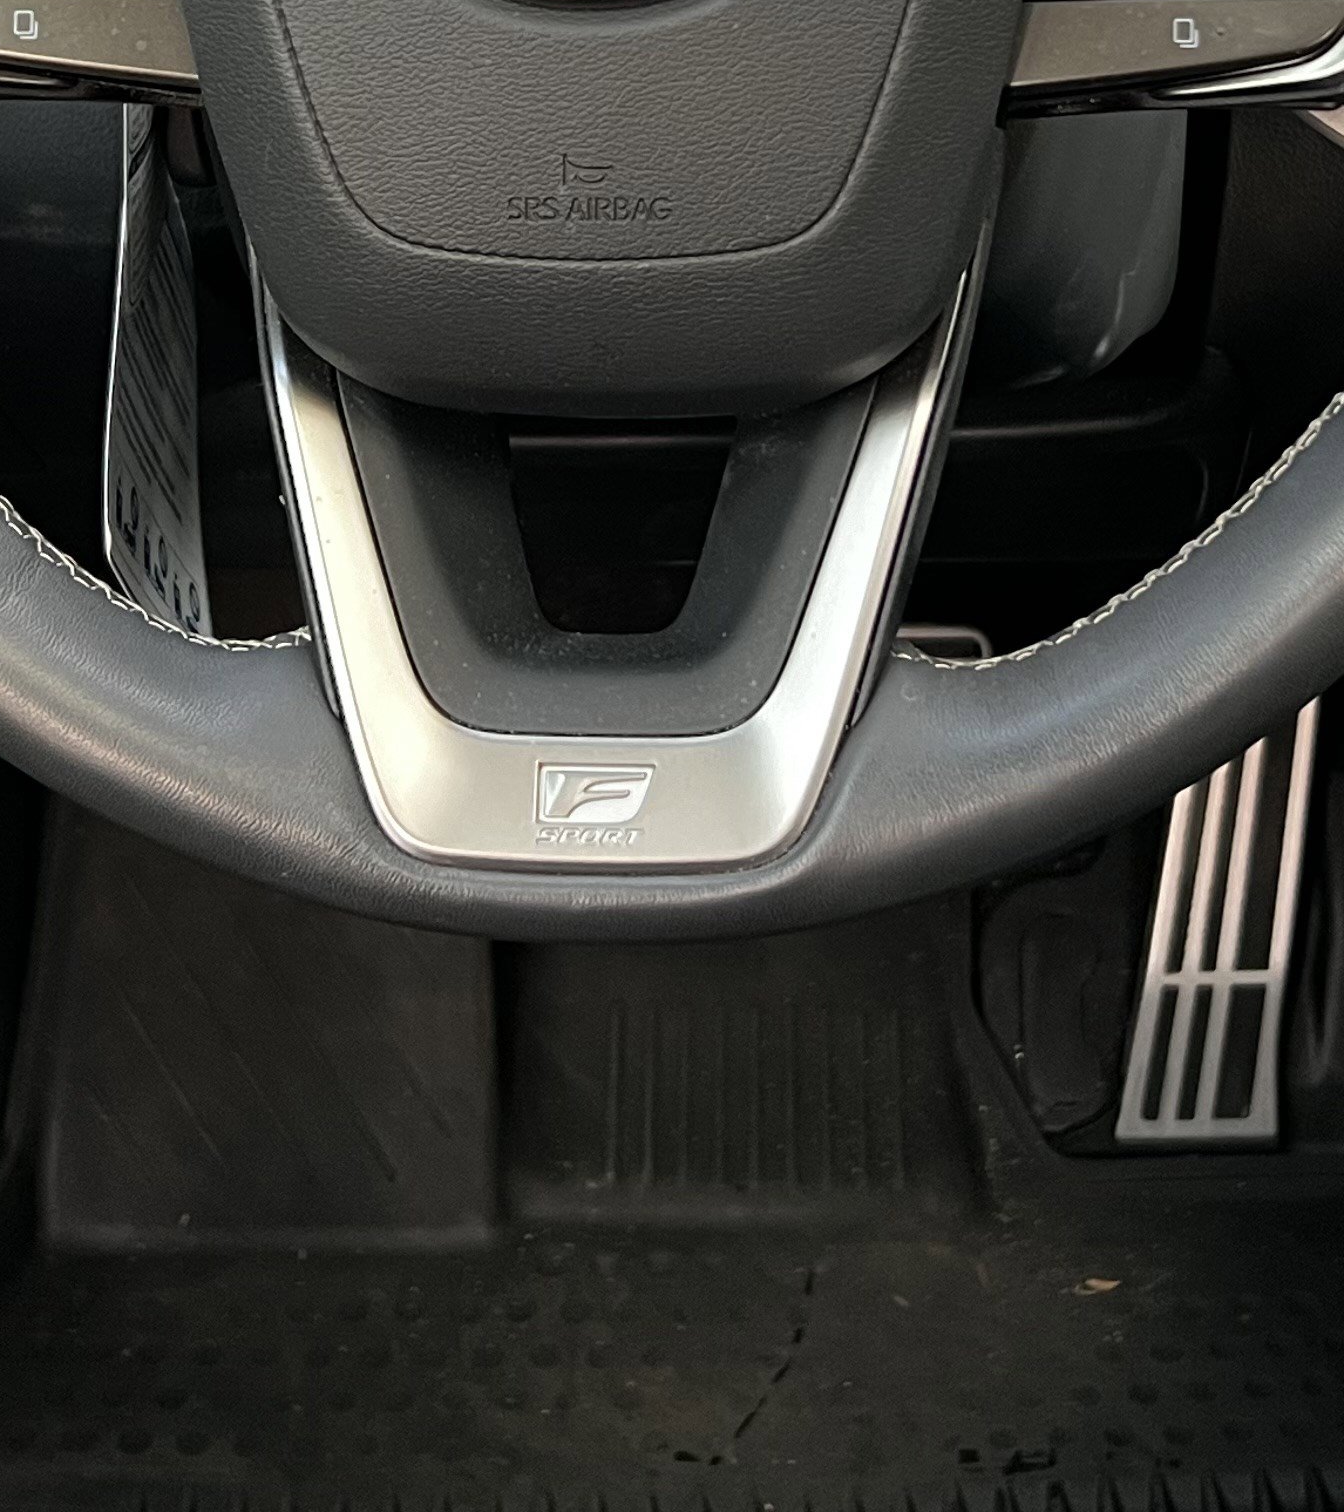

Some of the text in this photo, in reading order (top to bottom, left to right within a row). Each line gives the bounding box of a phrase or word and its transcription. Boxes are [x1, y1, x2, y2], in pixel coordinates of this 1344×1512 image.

[507, 196, 673, 221] SRS AIRBAG
[536, 826, 644, 847] SPORT
